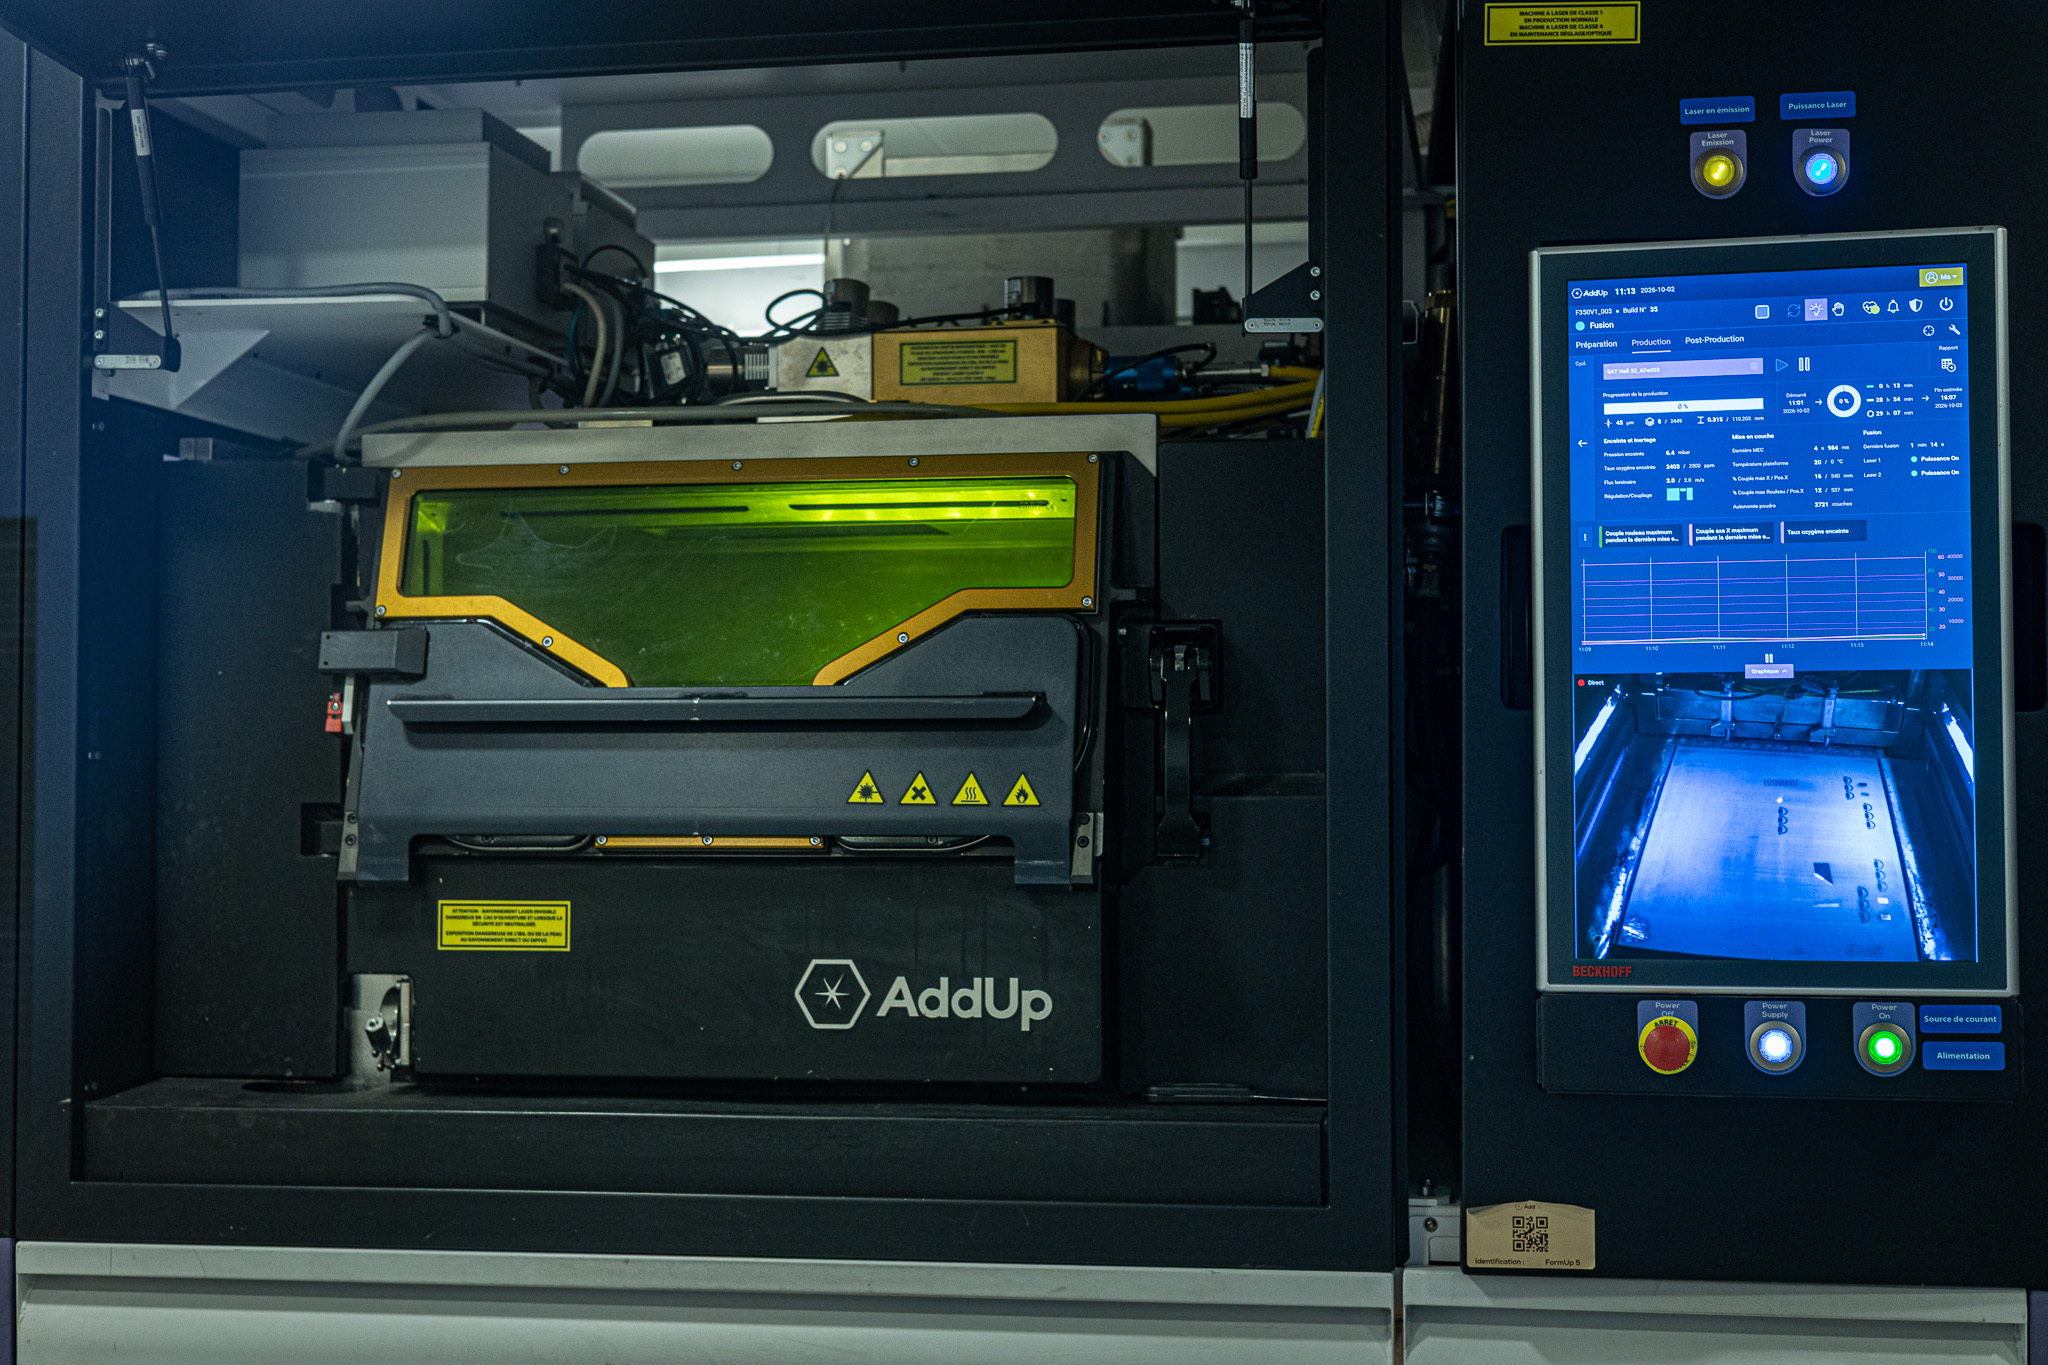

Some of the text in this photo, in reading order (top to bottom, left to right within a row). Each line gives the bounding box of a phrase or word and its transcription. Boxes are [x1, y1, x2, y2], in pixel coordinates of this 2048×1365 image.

[1583, 289, 1609, 298] AddUp
[1575, 340, 1618, 350] Préparation
[1685, 335, 1745, 344] Post-Production
[1572, 965, 1632, 978] BECKHOFF
[876, 976, 1053, 1031] AddUp
[1761, 1011, 1789, 1020] Supply
[1924, 1015, 1952, 1023] Source
[1654, 1019, 1679, 1028] ARRET
[1936, 1051, 1991, 1061] Alimentation
